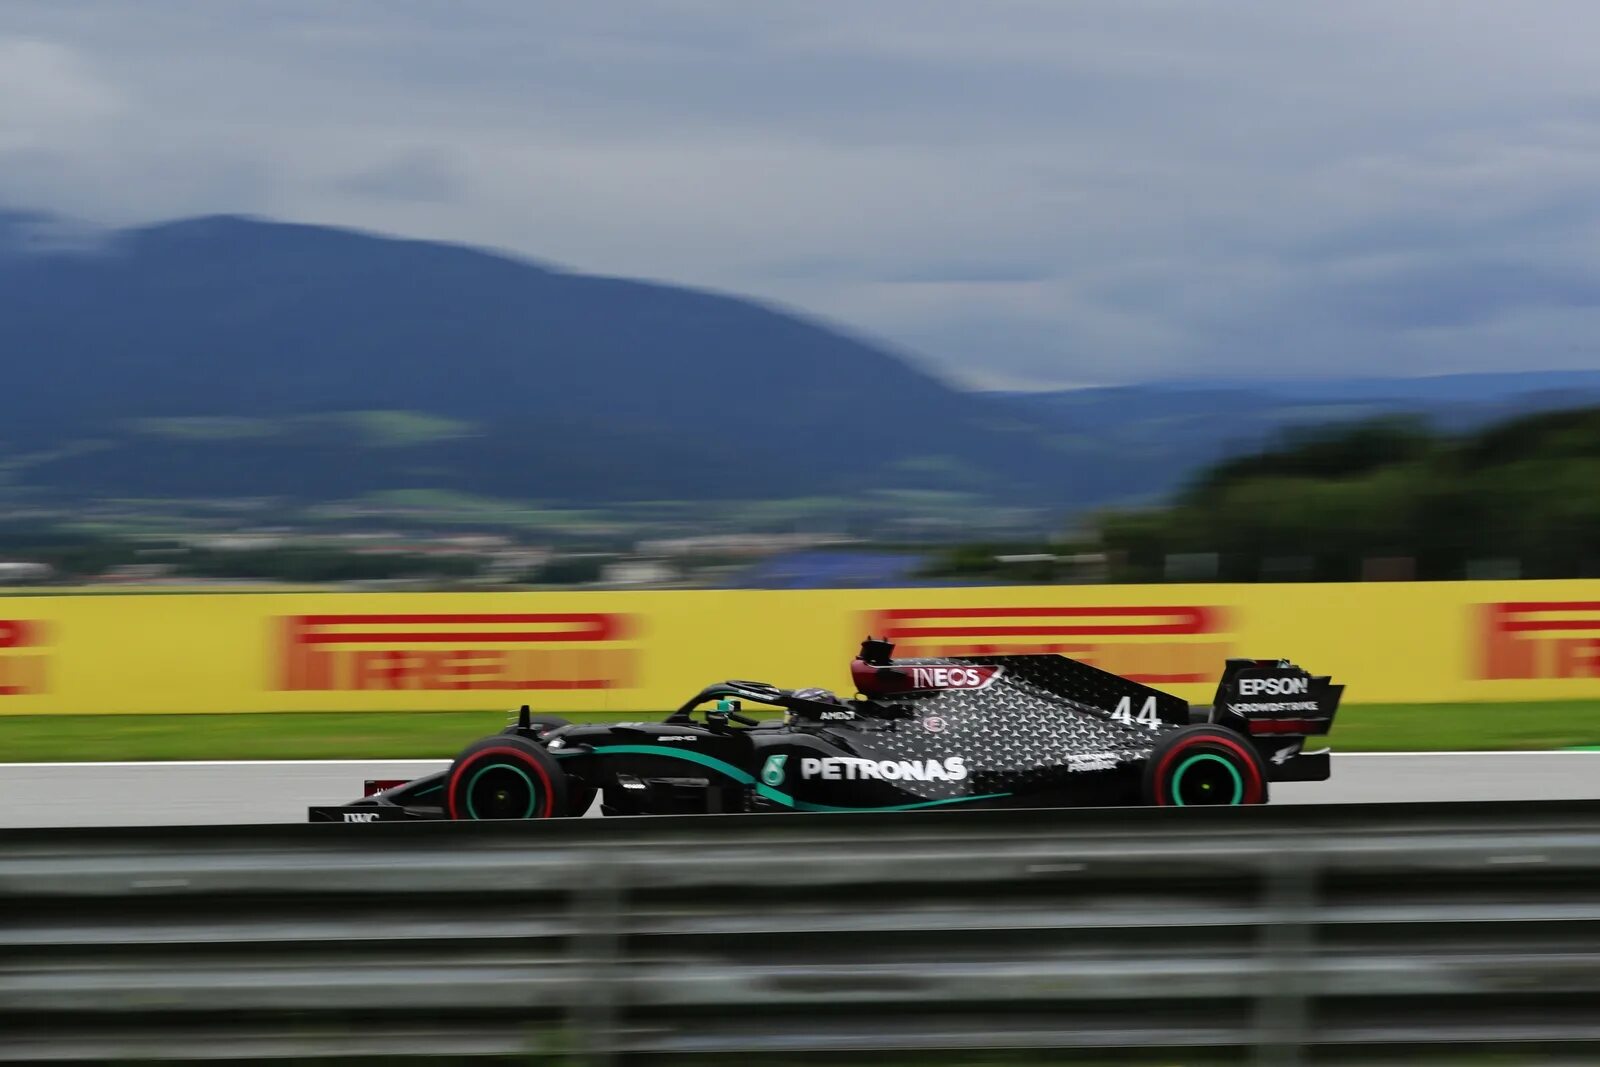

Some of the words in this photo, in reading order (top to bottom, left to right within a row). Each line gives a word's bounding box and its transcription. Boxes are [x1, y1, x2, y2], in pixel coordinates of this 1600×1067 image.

[912, 668, 981, 688] INEOS
[1239, 678, 1309, 695] EPSON
[1110, 696, 1162, 730] 44
[801, 757, 967, 781] PETRONAS
[342, 813, 380, 823] IWC
